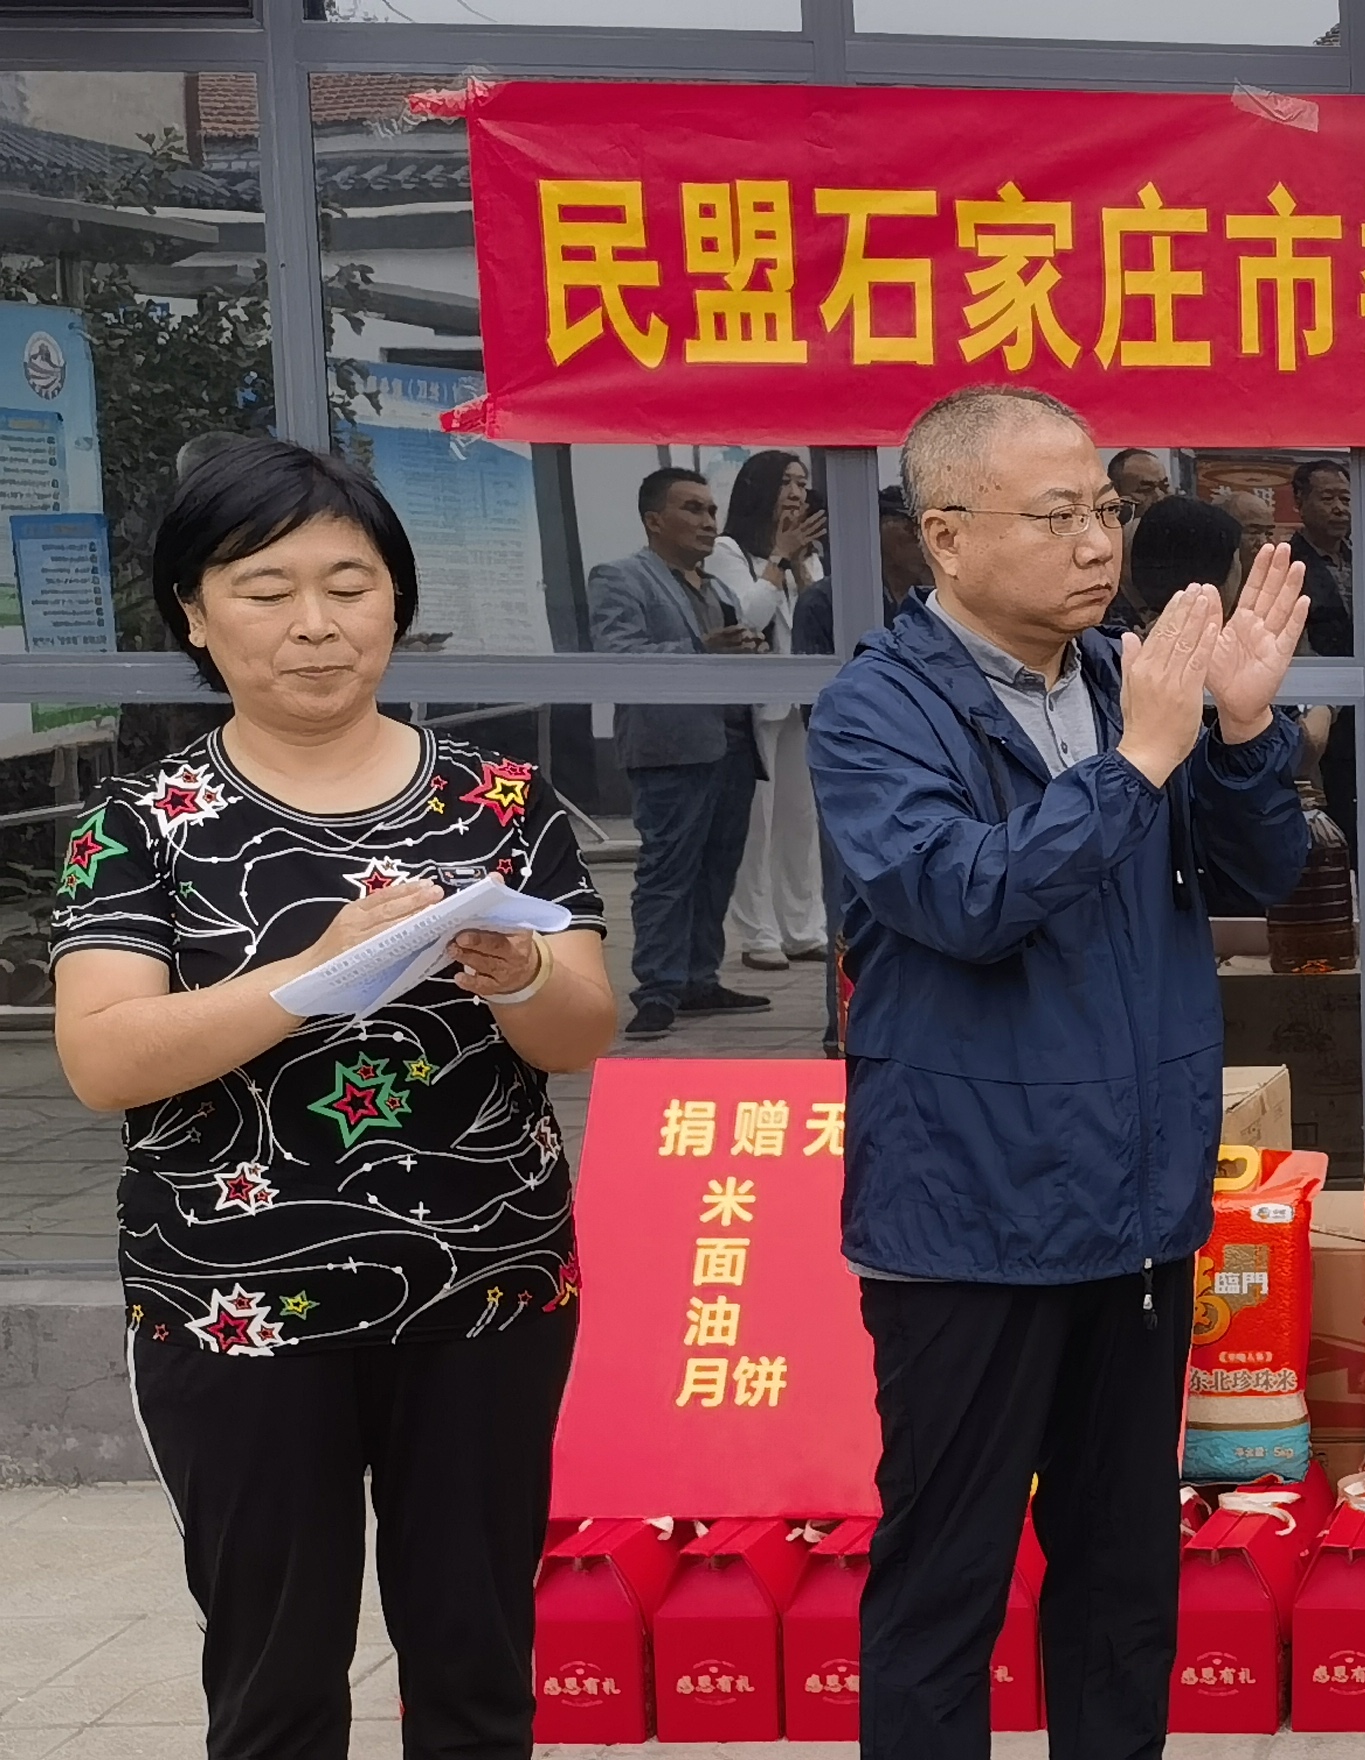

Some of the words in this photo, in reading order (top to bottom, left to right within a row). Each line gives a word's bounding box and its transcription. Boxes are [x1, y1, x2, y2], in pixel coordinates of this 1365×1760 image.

[1189, 1367, 1297, 1394] 东北珍珠米
[1181, 1667, 1256, 1685] 感恩有礼
